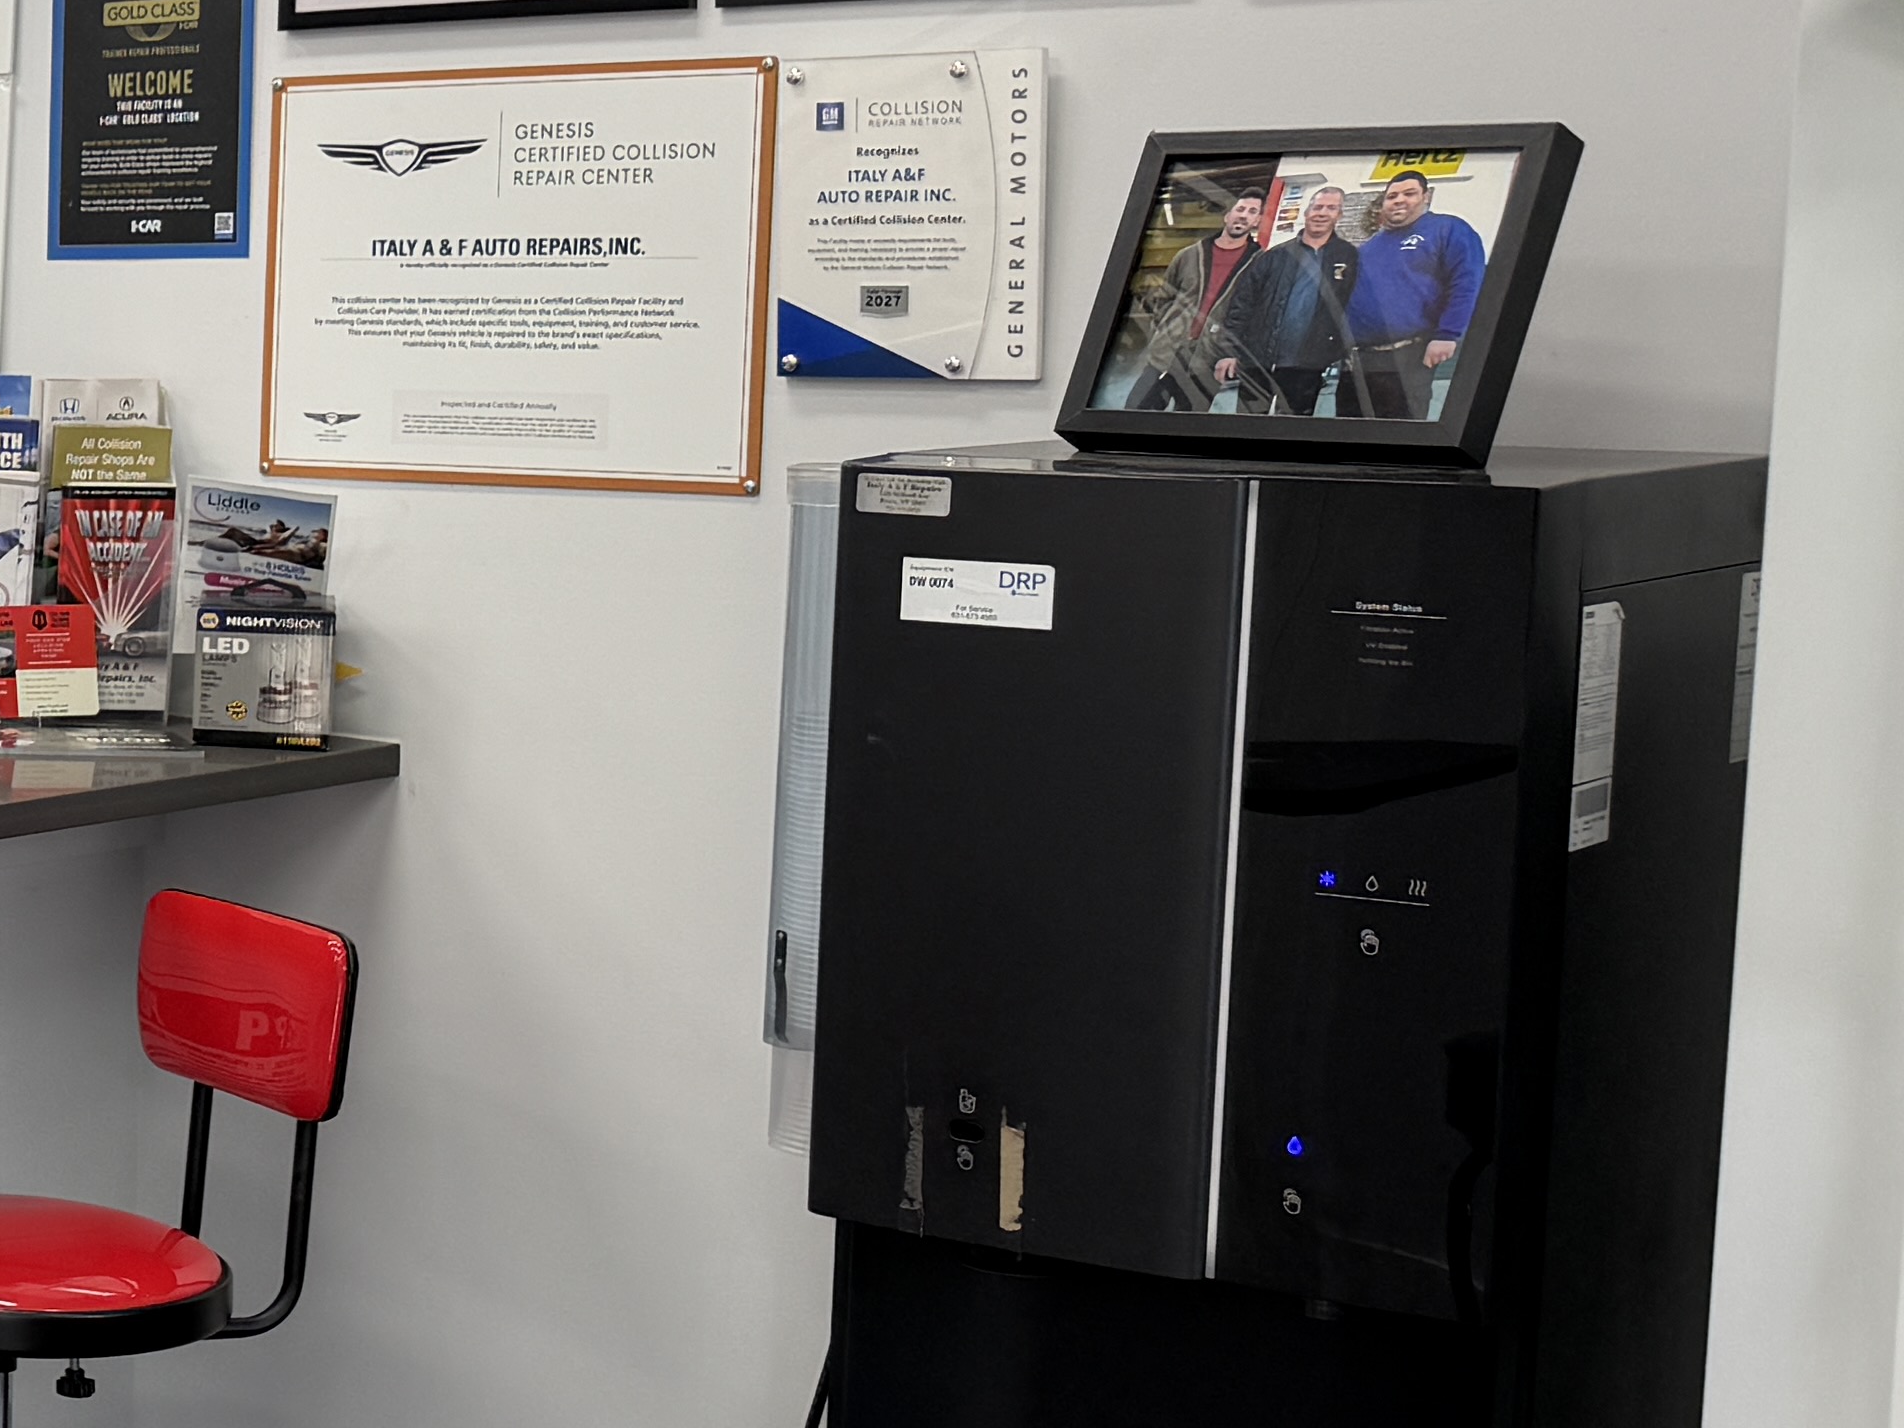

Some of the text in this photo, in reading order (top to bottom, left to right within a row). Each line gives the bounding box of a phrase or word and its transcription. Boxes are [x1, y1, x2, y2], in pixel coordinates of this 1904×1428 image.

[108, 2, 195, 21] GOLD CLASS
[108, 69, 193, 97] WELCOME
[868, 100, 963, 117] COLLISION
[515, 122, 594, 141] GENESIS
[514, 142, 716, 163] CERTIFIED COLLISION
[856, 146, 919, 159] Recognizes
[513, 167, 654, 186] REPAIR CENTER
[848, 168, 925, 183] ITALY A&F
[818, 189, 956, 204] AUTO REPAIR INC.
[1007, 67, 1028, 358] GENERAL MOTORS
[372, 239, 417, 257] ITALY
[422, 240, 434, 256] A
[439, 240, 453, 256] &
[458, 239, 468, 256] F
[472, 239, 521, 256] AUTO
[865, 295, 901, 308] 2027
[81, 438, 141, 450] All Collision
[66, 453, 155, 466] Repair Shops Are
[71, 469, 147, 481] NOT the Same
[909, 576, 954, 588] DW 0074
[999, 570, 1047, 591] DRP
[226, 616, 322, 629] NIGHTVISION
[202, 637, 250, 654] LED
